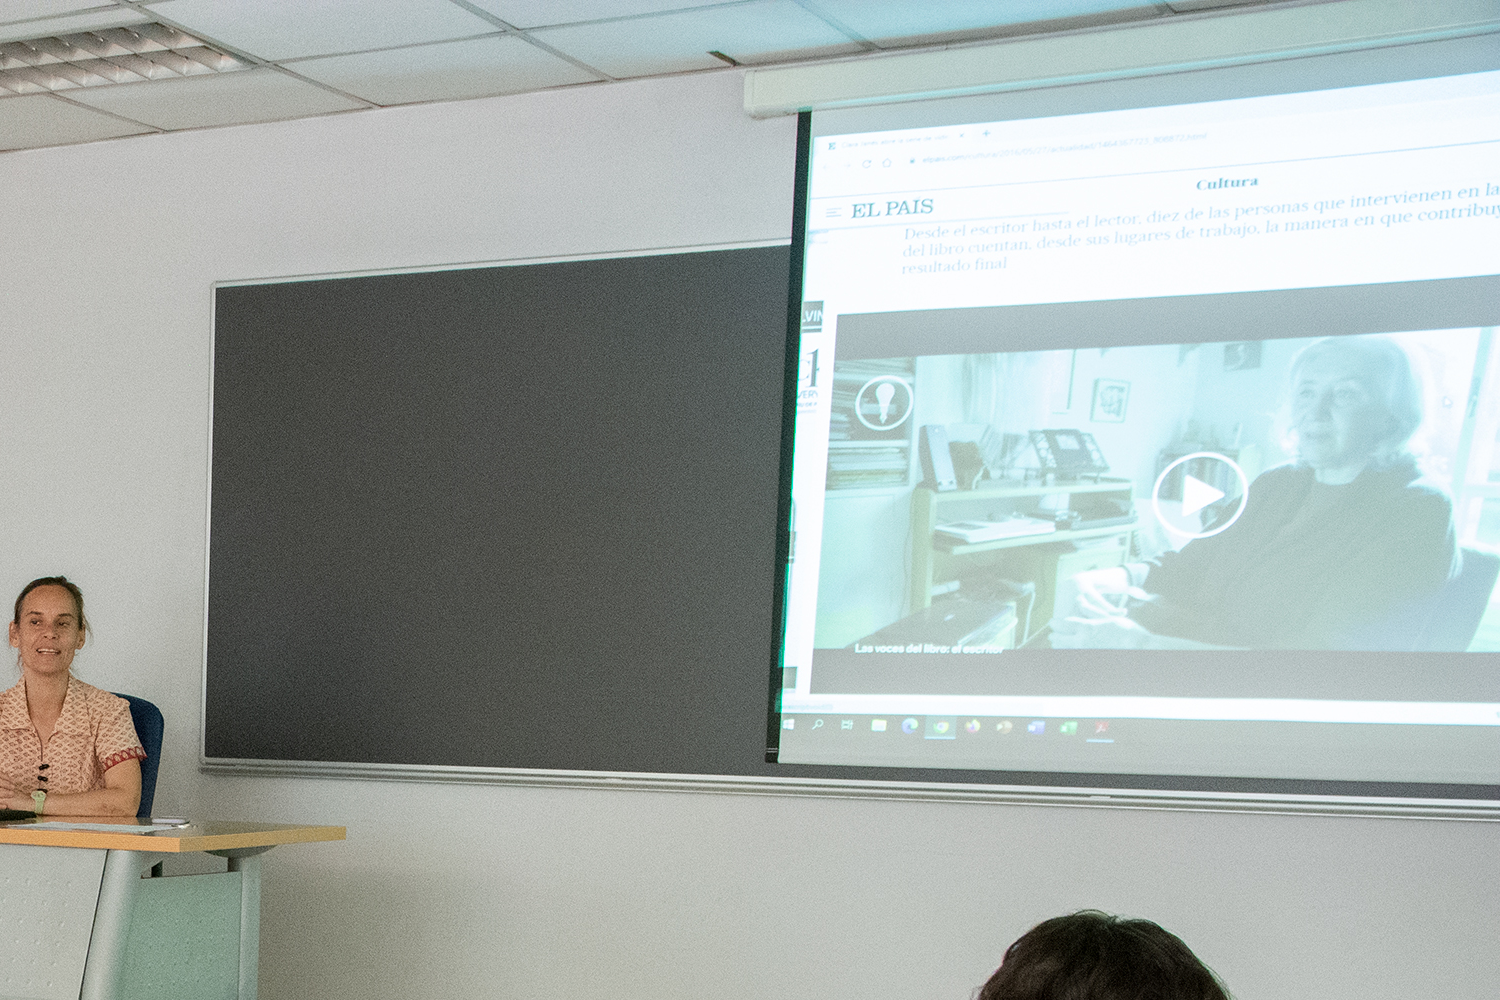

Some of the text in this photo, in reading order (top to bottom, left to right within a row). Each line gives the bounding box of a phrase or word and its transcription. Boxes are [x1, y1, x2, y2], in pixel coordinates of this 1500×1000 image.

[1196, 176, 1259, 191] Cultura
[851, 202, 881, 219] EL
[904, 226, 949, 240] Desde
[954, 224, 967, 238] el
[970, 221, 1029, 236] escritor
[1033, 219, 1072, 232] hasta
[1077, 215, 1090, 228] el
[1146, 210, 1180, 224] diez
[1184, 207, 1204, 221] de
[1208, 205, 1230, 220] las
[1234, 200, 1309, 220] personas
[1313, 198, 1345, 216] que
[1350, 189, 1452, 208] intervienen
[1457, 186, 1480, 199] en
[1485, 182, 1500, 197] la
[902, 243, 926, 257] del
[929, 242, 964, 256] libro
[1036, 235, 1081, 249] desde
[1085, 233, 1110, 246] sus
[1114, 229, 1171, 247] lugares
[1175, 225, 1195, 240] de
[1265, 219, 1279, 233] la
[1284, 217, 1349, 232] manera
[1354, 214, 1375, 227] en
[1380, 211, 1413, 228] que
[901, 256, 1008, 275] resultado final
[854, 643, 1004, 654] Las voces del libro: el escritor
